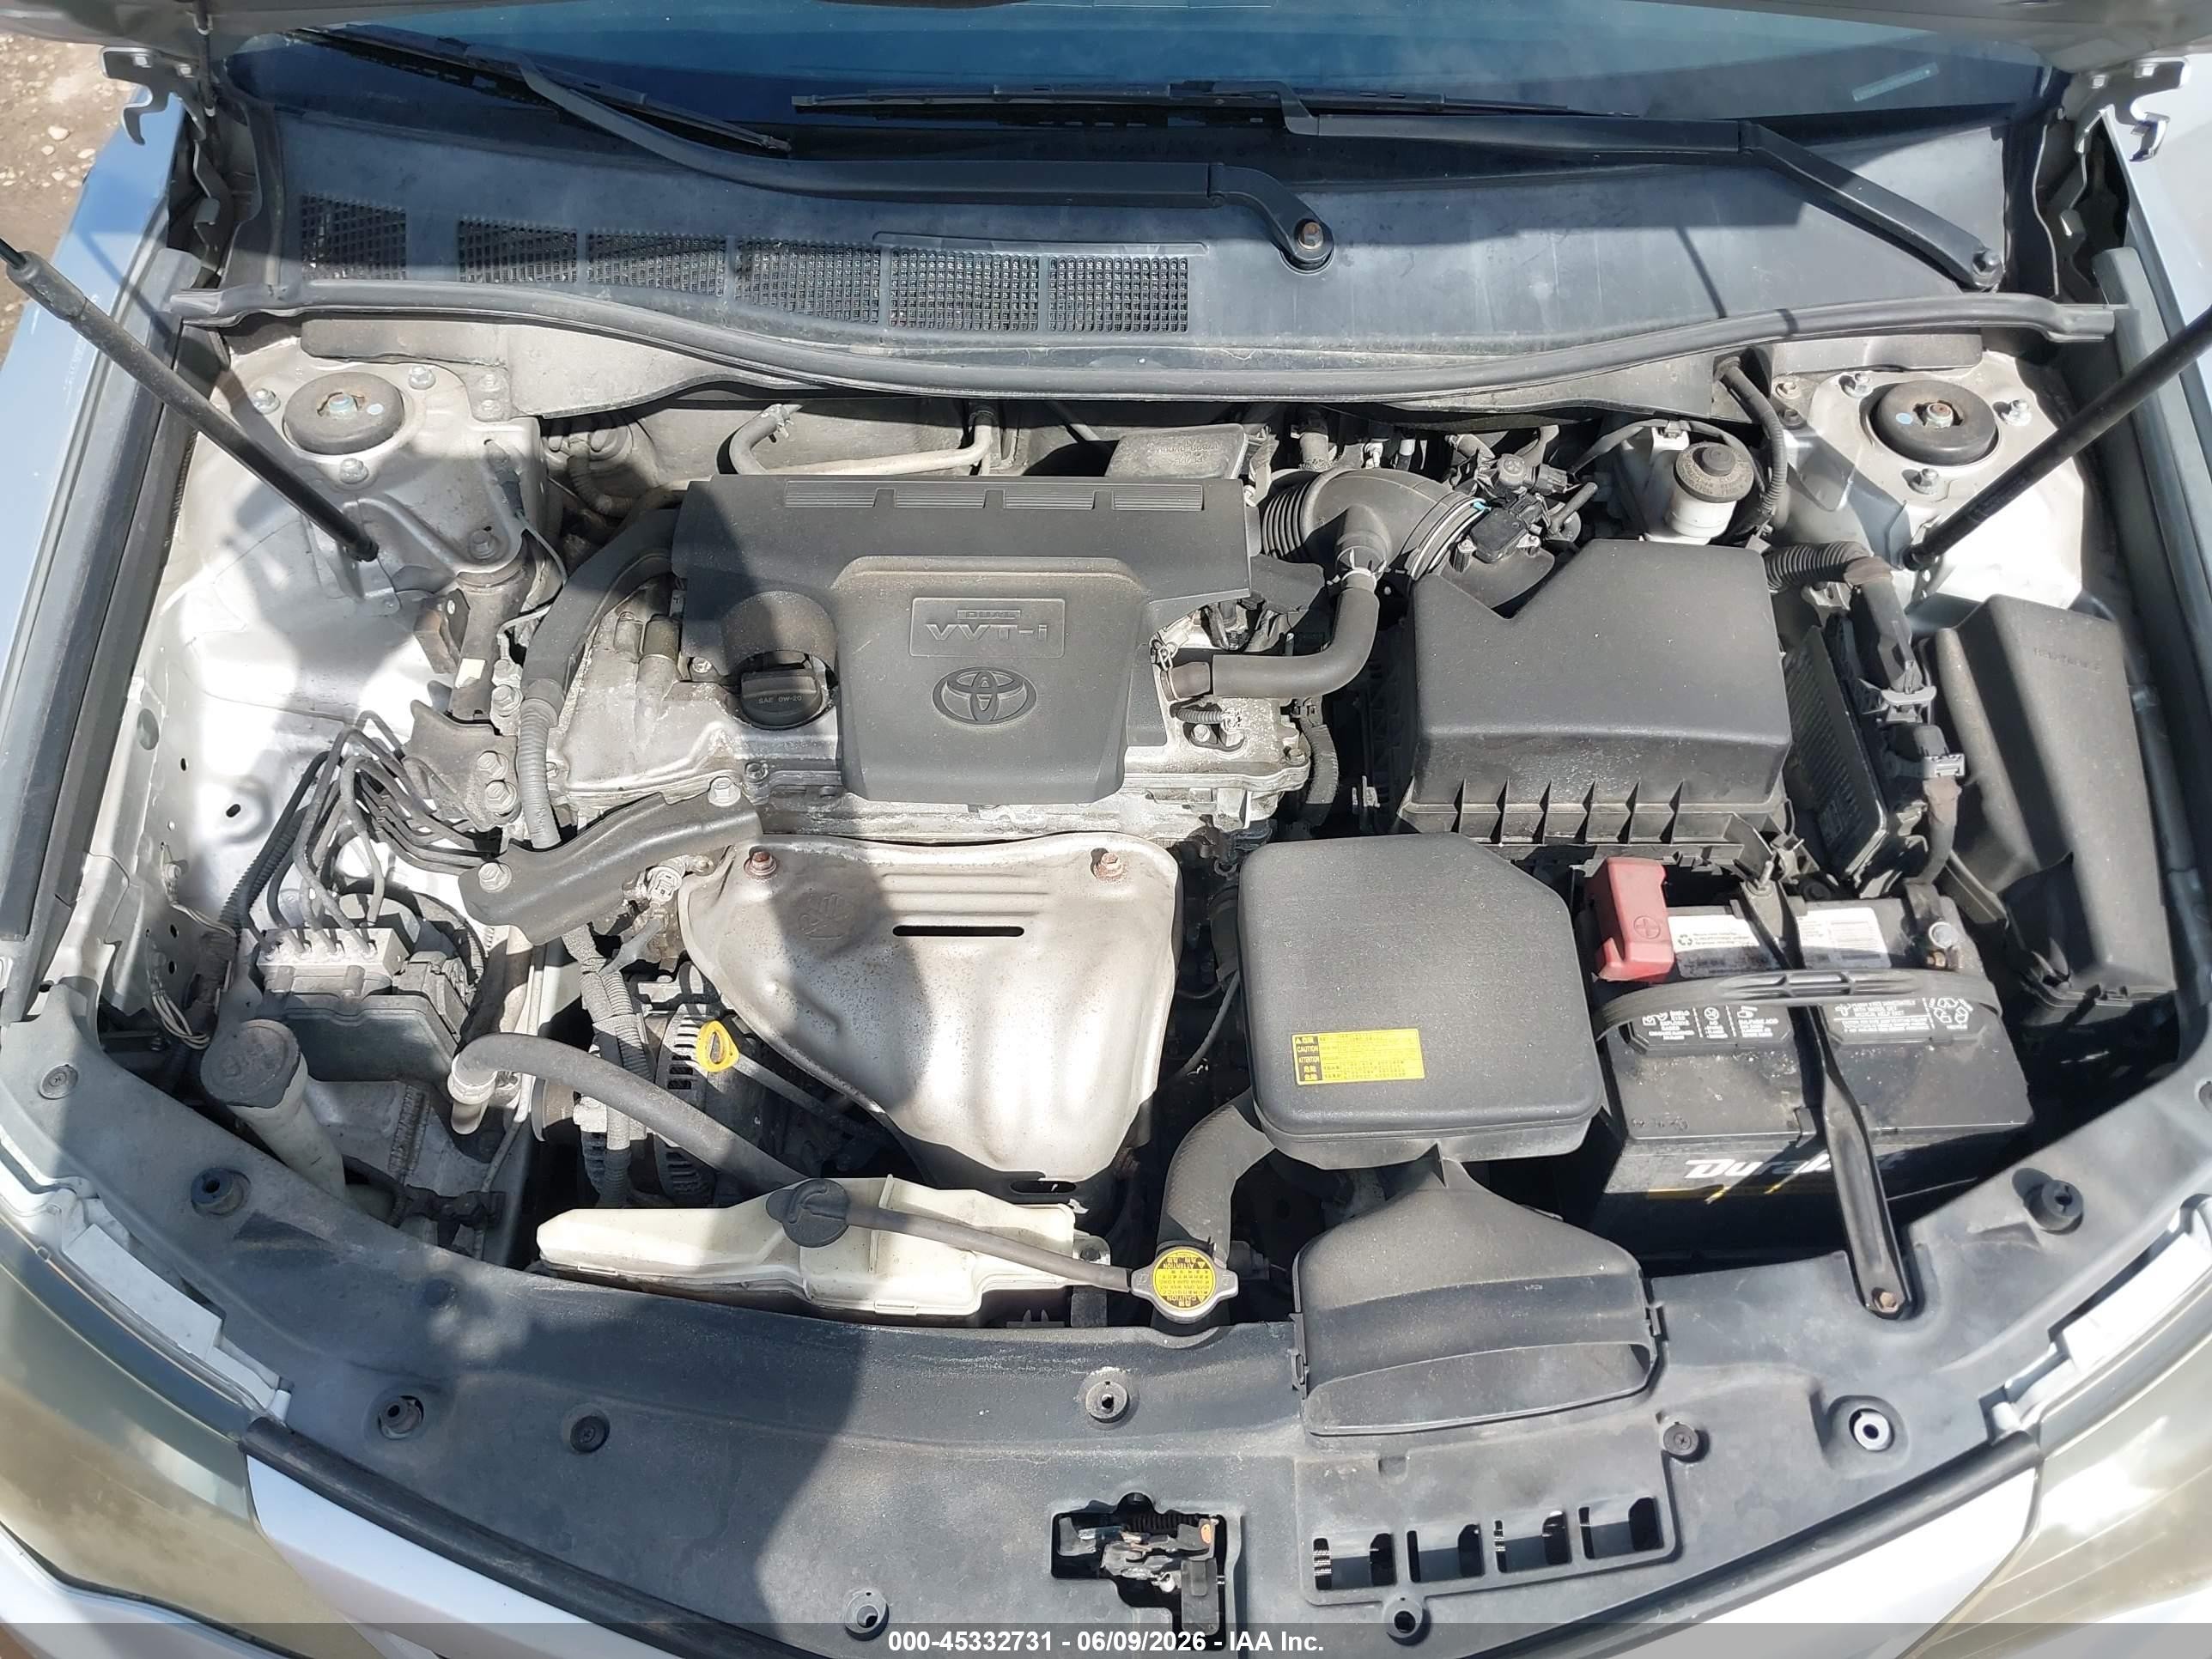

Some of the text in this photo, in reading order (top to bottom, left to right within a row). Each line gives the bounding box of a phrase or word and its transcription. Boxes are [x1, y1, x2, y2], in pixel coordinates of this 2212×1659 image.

[965, 611, 1017, 619] DUAL
[925, 623, 1048, 641] VVT-i
[1297, 1044, 1319, 1053] CAUTION
